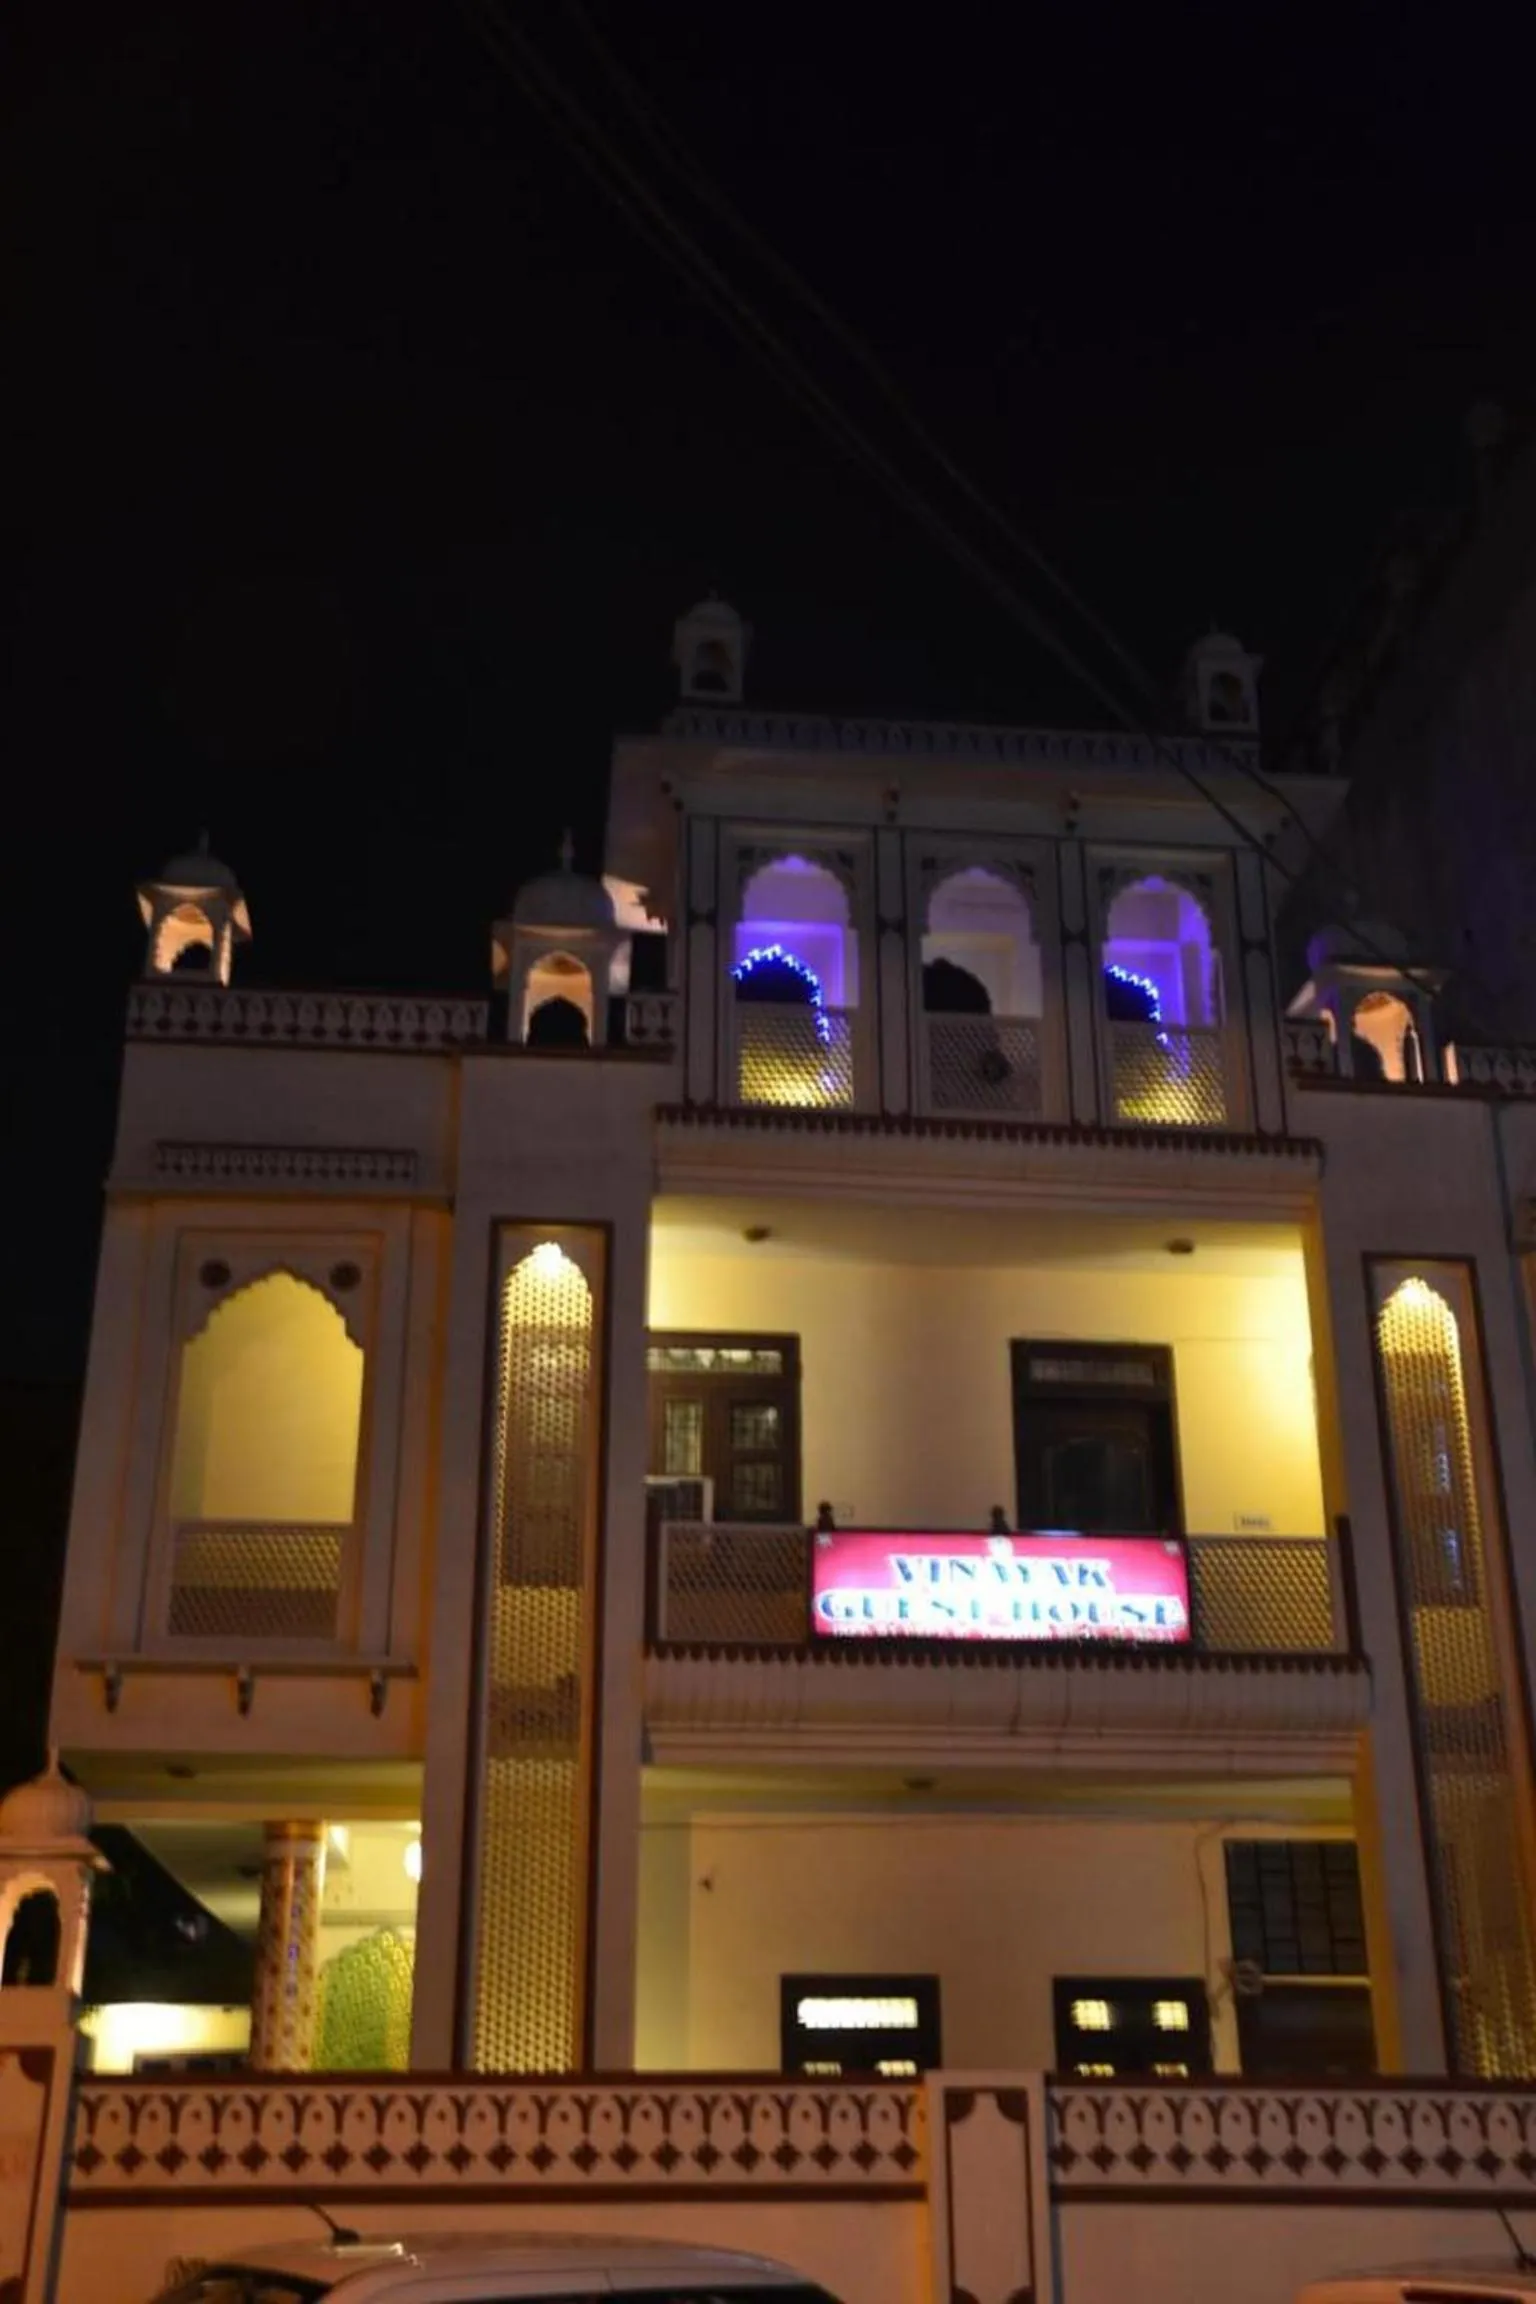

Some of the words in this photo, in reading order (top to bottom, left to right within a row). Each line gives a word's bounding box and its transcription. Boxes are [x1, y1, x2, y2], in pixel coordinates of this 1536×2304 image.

[892, 1555, 1110, 1588] VINAYAK
[817, 1592, 987, 1620] GUEST
[1009, 1596, 1185, 1627] HOUSE
